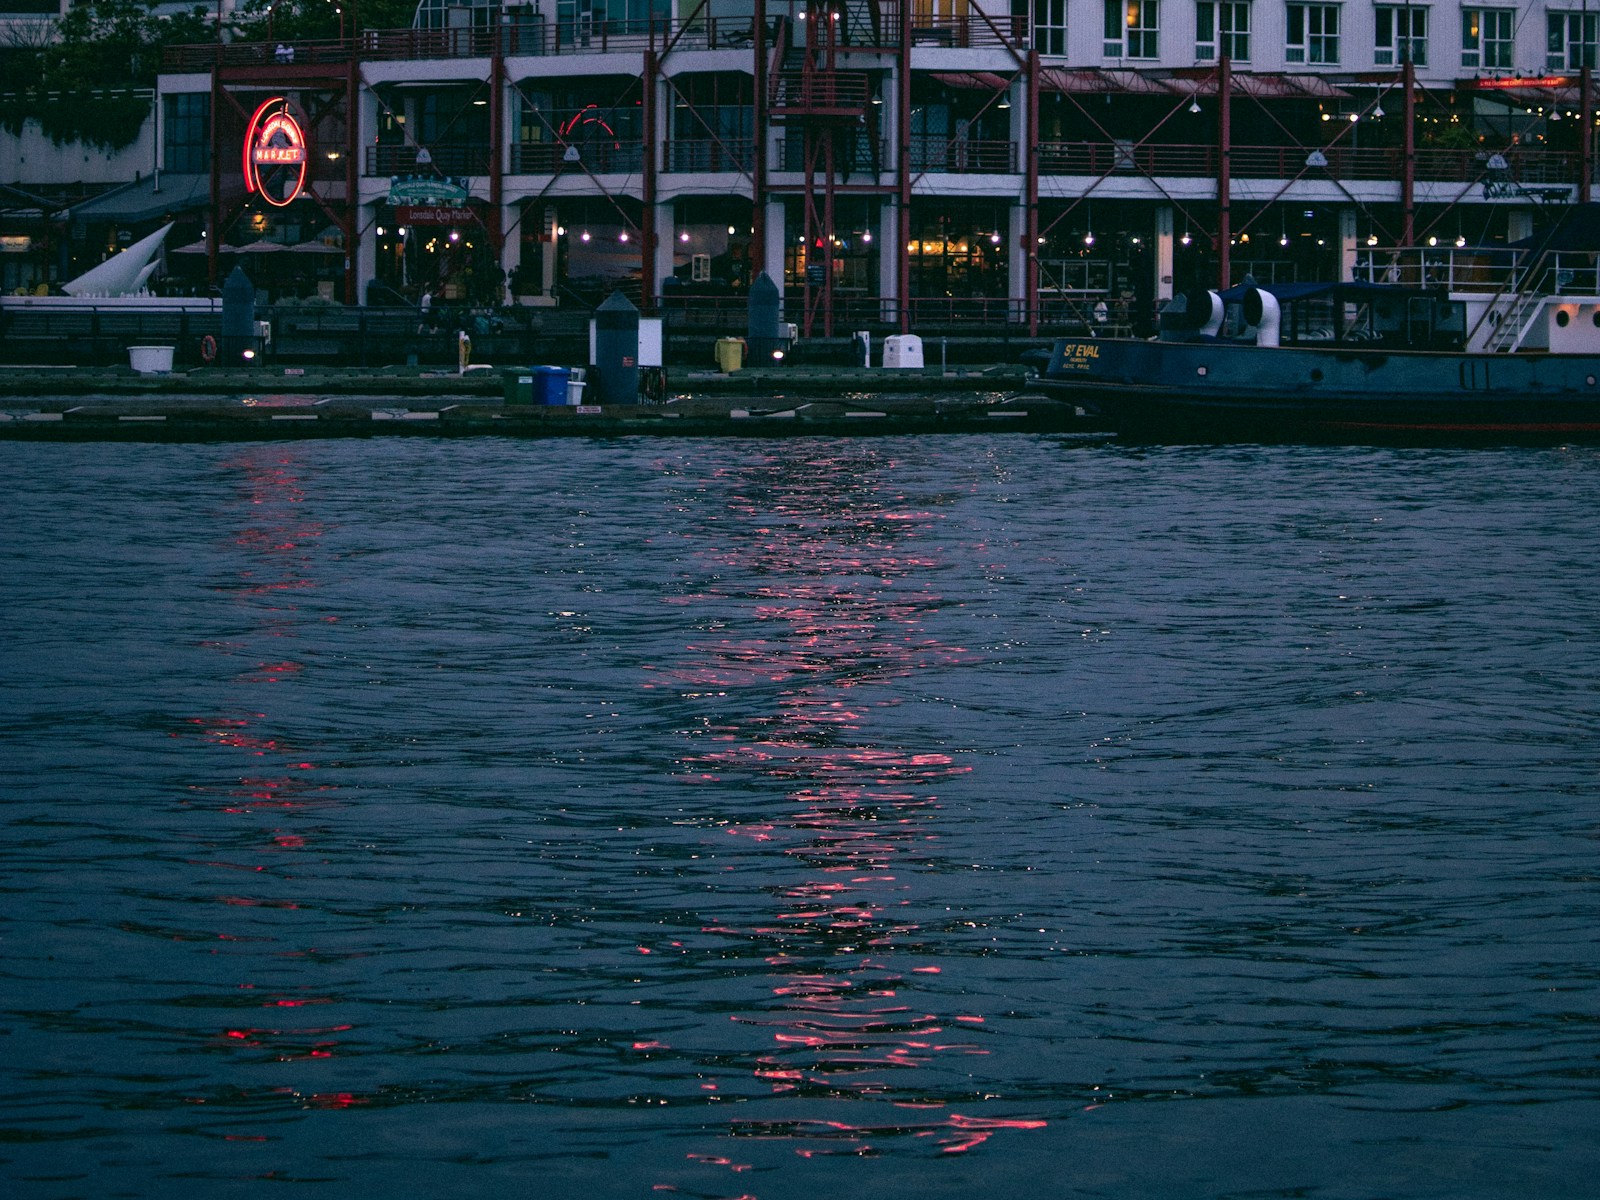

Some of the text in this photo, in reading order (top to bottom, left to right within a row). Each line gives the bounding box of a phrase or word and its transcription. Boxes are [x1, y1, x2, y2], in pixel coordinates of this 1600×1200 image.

[256, 149, 299, 161] MARKET
[409, 209, 435, 220] Lonsdale
[435, 208, 451, 223] Quay
[1075, 344, 1100, 358] EVAL
